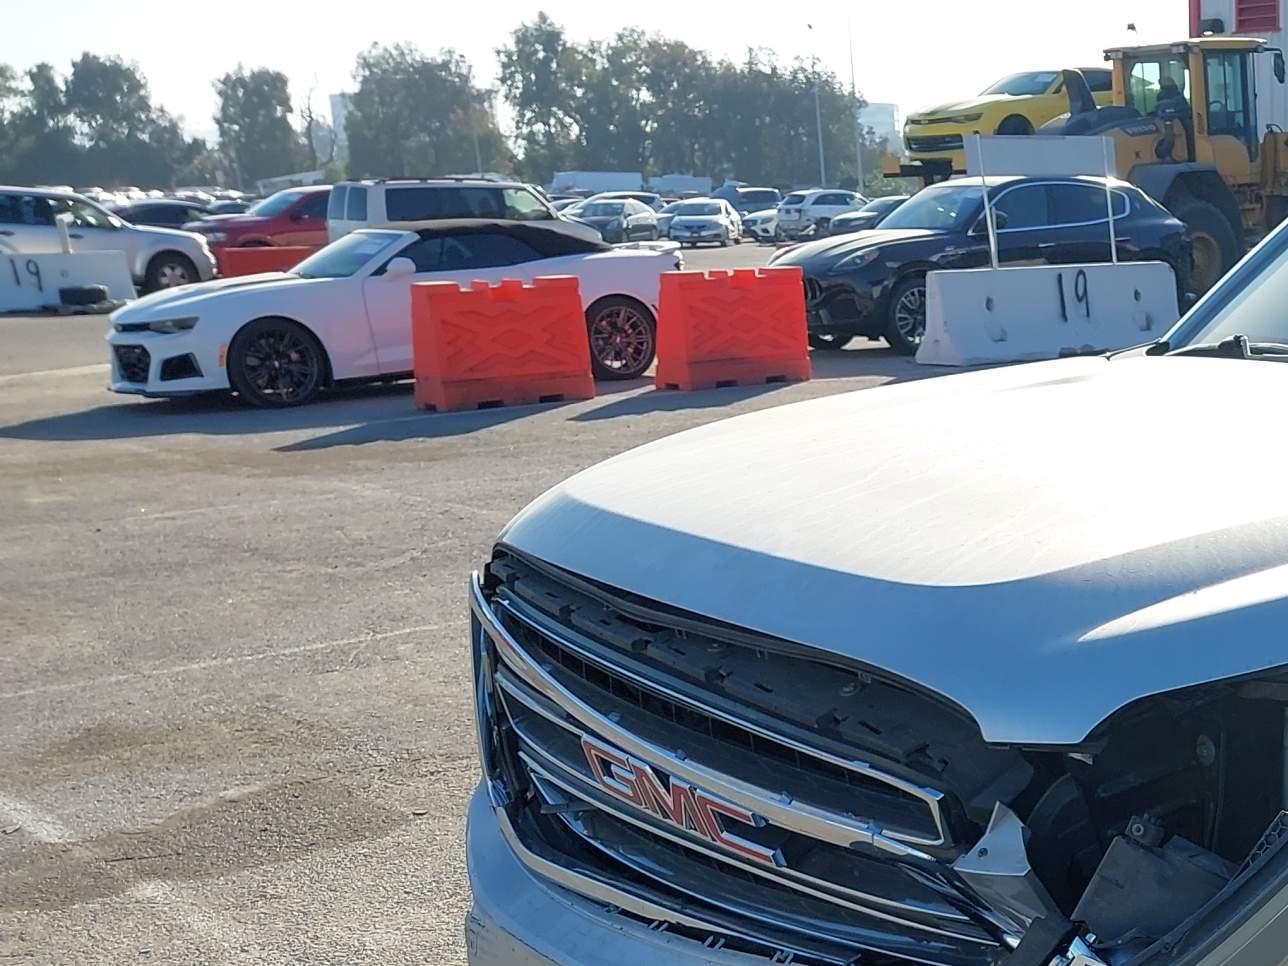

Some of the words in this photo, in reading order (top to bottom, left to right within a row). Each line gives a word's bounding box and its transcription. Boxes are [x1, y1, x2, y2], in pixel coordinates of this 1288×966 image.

[9, 257, 43, 294] 19
[1057, 268, 1090, 323] 19
[581, 733, 788, 868] GMC
